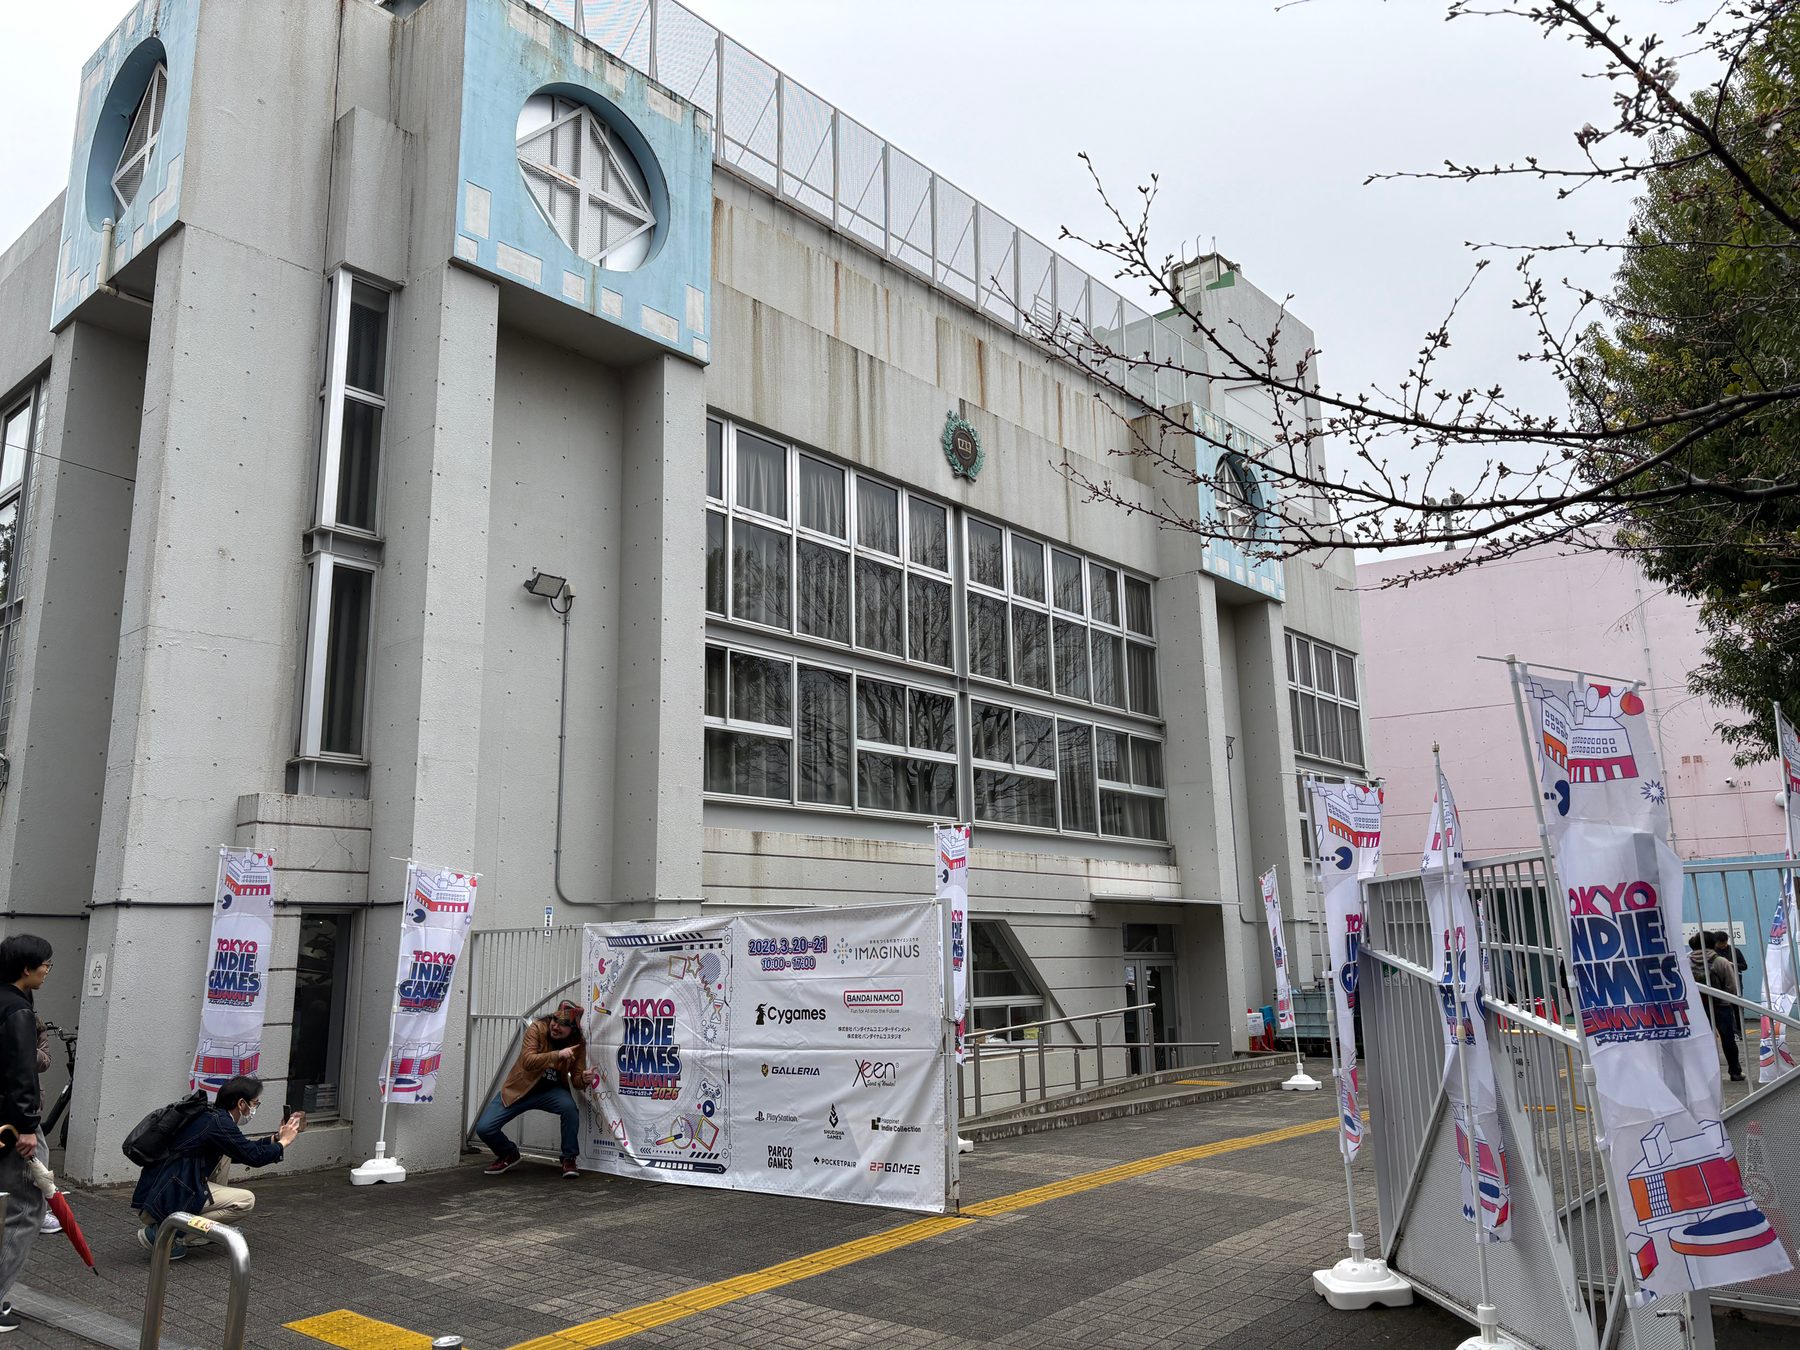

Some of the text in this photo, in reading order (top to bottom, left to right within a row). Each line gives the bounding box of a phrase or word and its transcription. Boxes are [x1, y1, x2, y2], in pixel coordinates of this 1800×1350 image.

[217, 938, 258, 953] TOKYO
[748, 936, 828, 956] 2026.3.20-21
[854, 944, 920, 961] IMAGINUS
[214, 951, 257, 972] INDIE
[413, 950, 456, 966] TOKYO
[761, 957, 785, 971] 10:00
[792, 956, 817, 970] 17:00
[410, 962, 454, 982] INDIE
[208, 970, 261, 992] GAMES
[846, 993, 900, 1003] BANDAI NAMCO
[622, 998, 676, 1018] TOKYO
[767, 1006, 827, 1025] Cygames
[1580, 1000, 1690, 1037] SUMMIT
[622, 1016, 677, 1046] INDIE
[617, 1044, 682, 1075] GAMES
[771, 1066, 820, 1076] GALLERIA
[852, 1058, 896, 1088] Xeen
[619, 1073, 681, 1089] SUMMIT
[651, 1087, 681, 1100] 2026
[766, 1113, 798, 1123] PlayStation
[893, 1125, 922, 1133] Collection
[767, 1145, 793, 1158] PARCO
[767, 1157, 793, 1170] GAMES
[821, 1158, 857, 1168] POCKETPAIR
[869, 1161, 921, 1175] 2PGAMES
